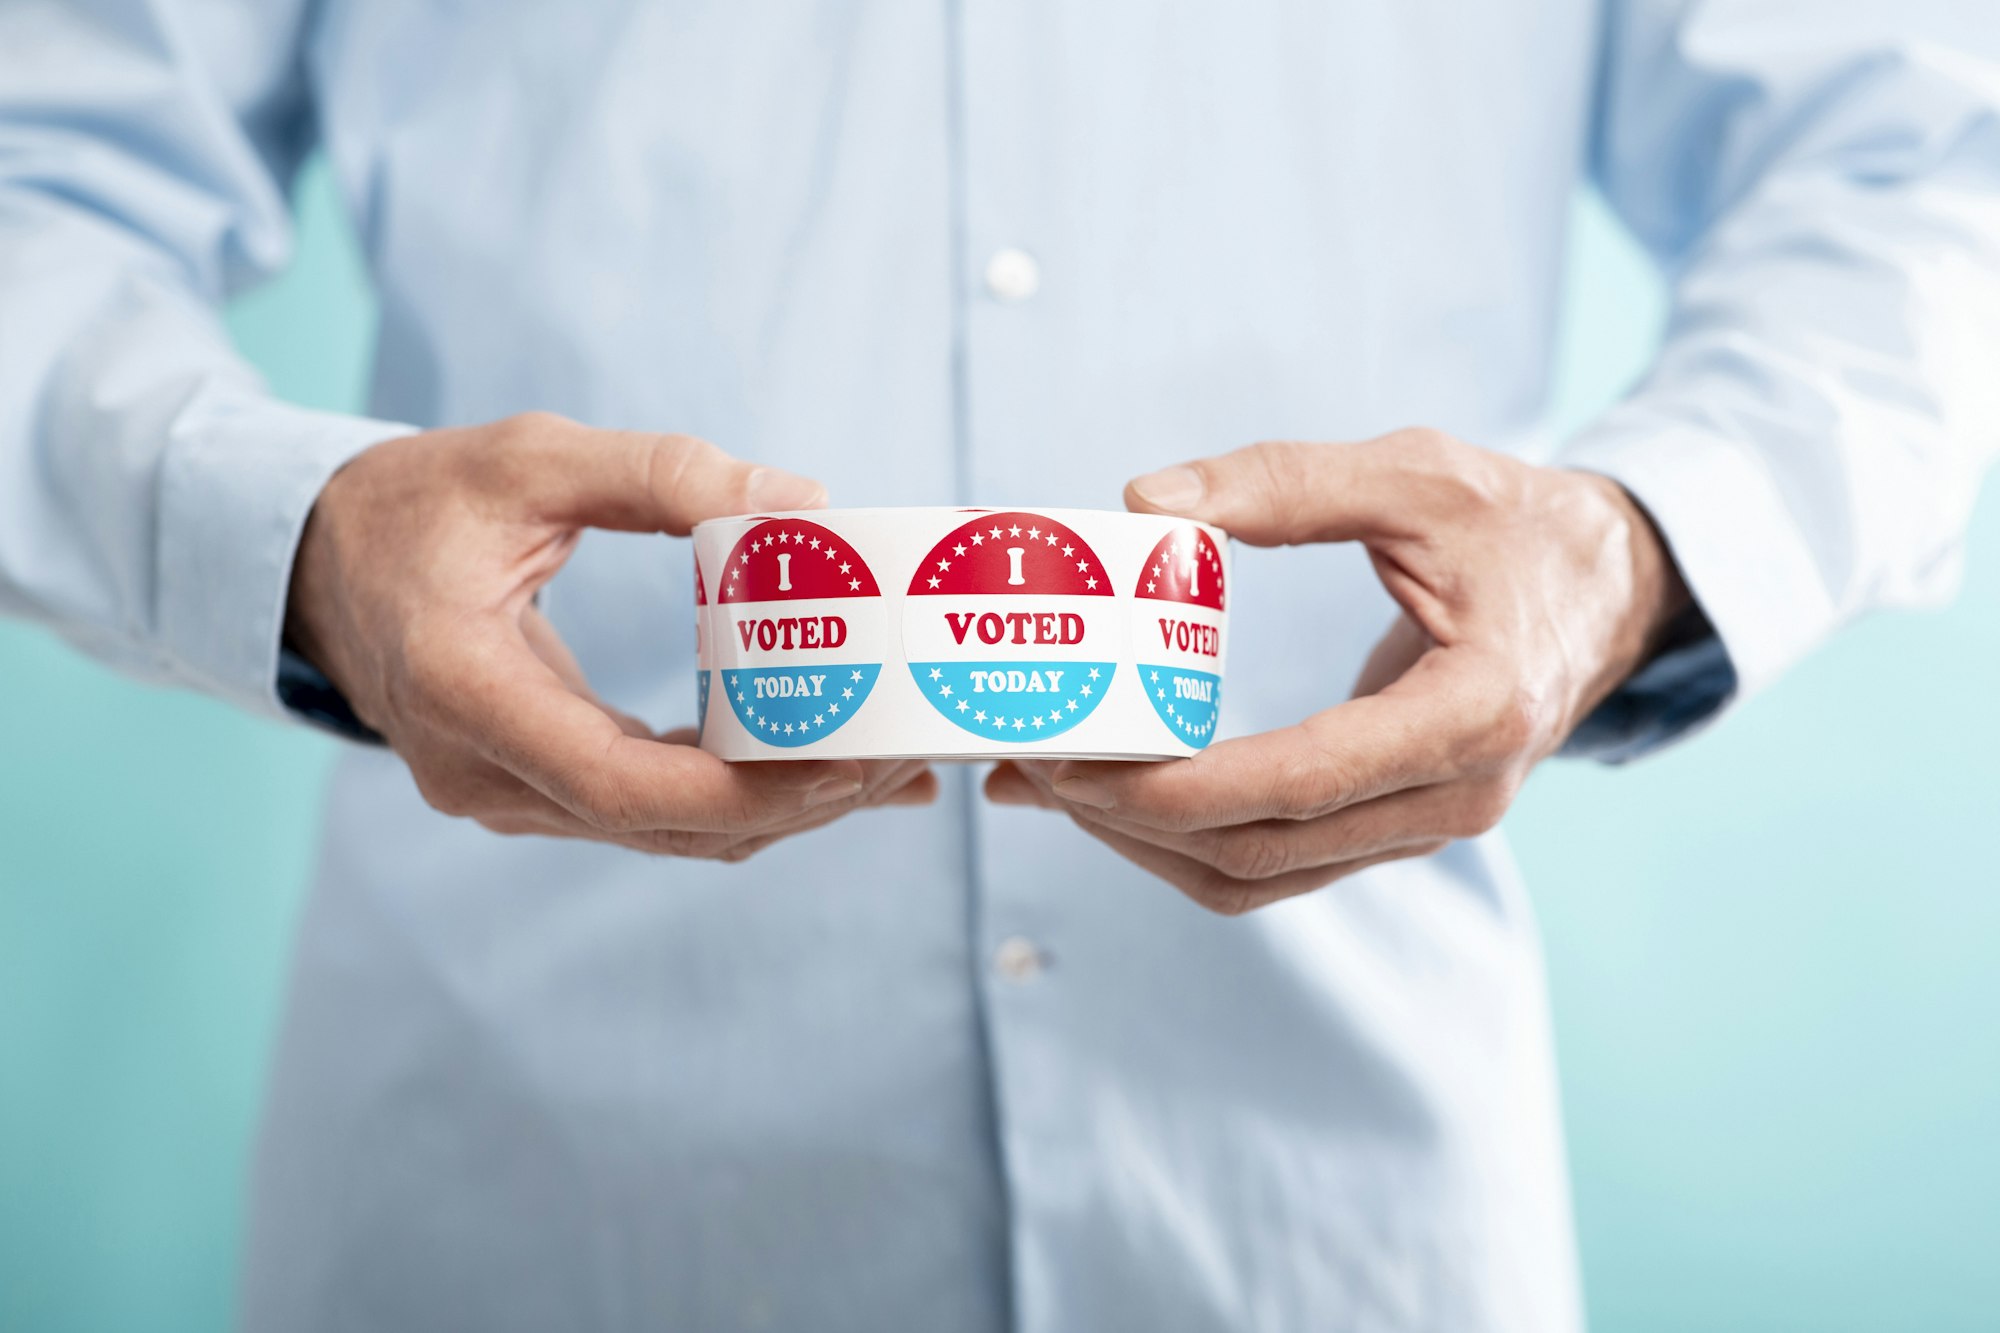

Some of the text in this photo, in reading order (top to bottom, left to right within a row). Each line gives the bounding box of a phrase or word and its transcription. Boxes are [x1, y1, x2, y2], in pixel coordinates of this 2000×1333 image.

[777, 553, 793, 591] I
[1006, 547, 1026, 586] I
[1189, 559, 1200, 597] I
[737, 616, 848, 652] VOTED
[943, 612, 1085, 646] VOTED
[1158, 618, 1219, 657] VOTED
[753, 674, 827, 699] TODAY
[969, 670, 1066, 693] TODAY
[1173, 675, 1213, 704] TODAY
